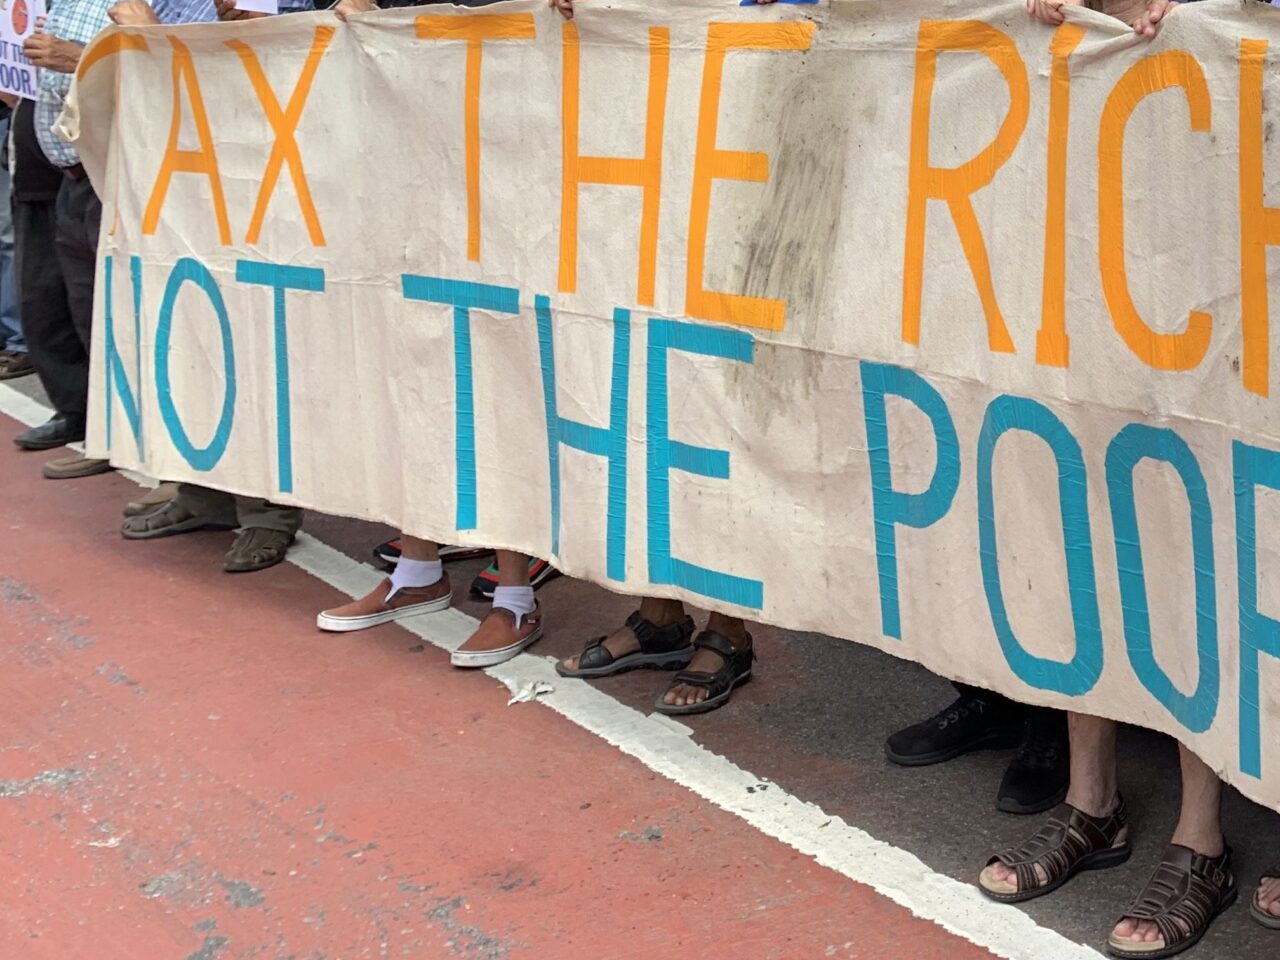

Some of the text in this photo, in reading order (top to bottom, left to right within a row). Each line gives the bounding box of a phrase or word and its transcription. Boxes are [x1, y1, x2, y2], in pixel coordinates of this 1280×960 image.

[0, 64, 36, 96] OOR.
[78, 26, 335, 248] TAX
[415, 12, 815, 330] THE
[104, 256, 324, 494] NOT
[401, 274, 764, 610] THE
